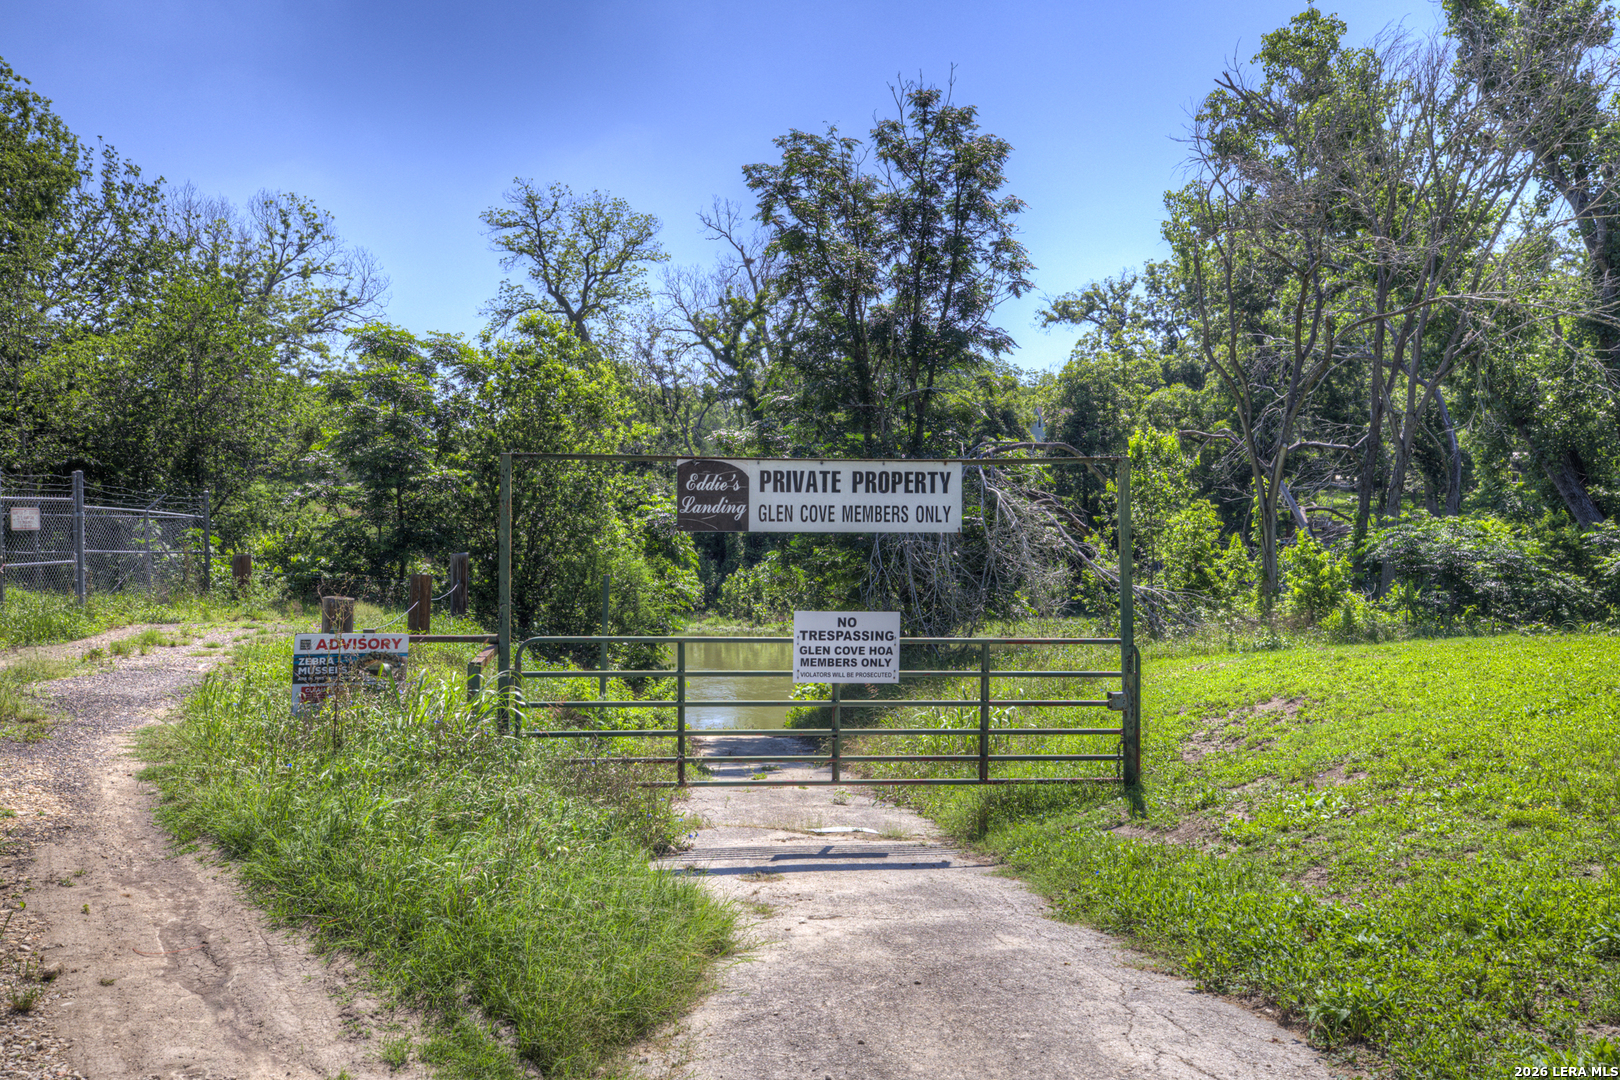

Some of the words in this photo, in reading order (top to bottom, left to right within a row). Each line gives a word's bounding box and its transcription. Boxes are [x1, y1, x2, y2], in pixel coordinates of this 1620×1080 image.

[686, 472, 741, 492] Eddie's
[759, 470, 841, 493] PRIVATE
[852, 470, 951, 494] PROPERTY
[679, 495, 747, 521] Landing
[758, 504, 793, 523] GLEN
[800, 504, 835, 523] COVE
[842, 505, 909, 523] MEMBERS
[916, 505, 951, 523] ONLY
[837, 617, 857, 628] NO
[800, 630, 894, 641] TRESPASSING
[315, 638, 403, 650] ADVISORY
[799, 646, 830, 655] GLEN
[834, 646, 865, 655] COVE
[869, 646, 893, 655] HOA
[298, 657, 335, 666] ZEBRA
[800, 658, 857, 667] MEMBERS
[861, 658, 892, 667] ONLY
